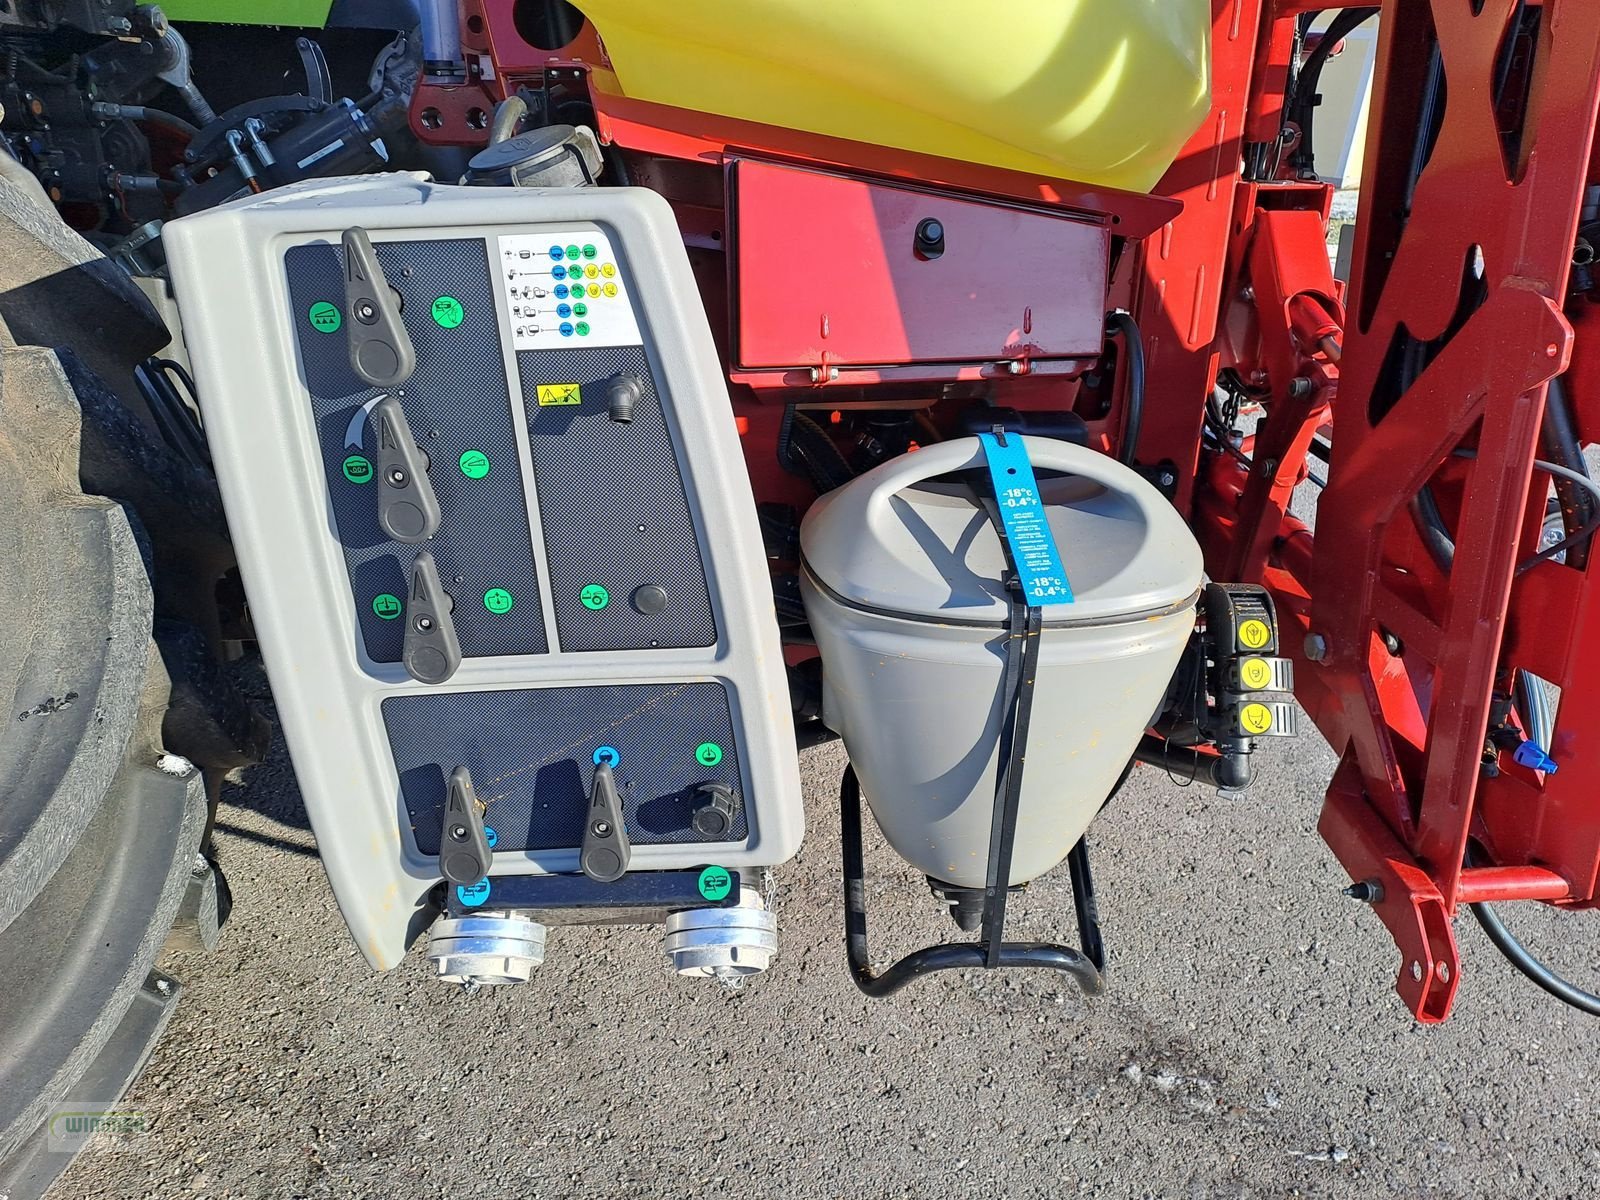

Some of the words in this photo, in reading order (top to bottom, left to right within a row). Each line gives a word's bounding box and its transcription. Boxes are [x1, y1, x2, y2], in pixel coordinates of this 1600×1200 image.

[1002, 487, 1033, 498] -18°C
[1002, 497, 1038, 507] -0.4°F
[1029, 576, 1062, 587] -18°C
[1029, 586, 1067, 597] -0.4°F
